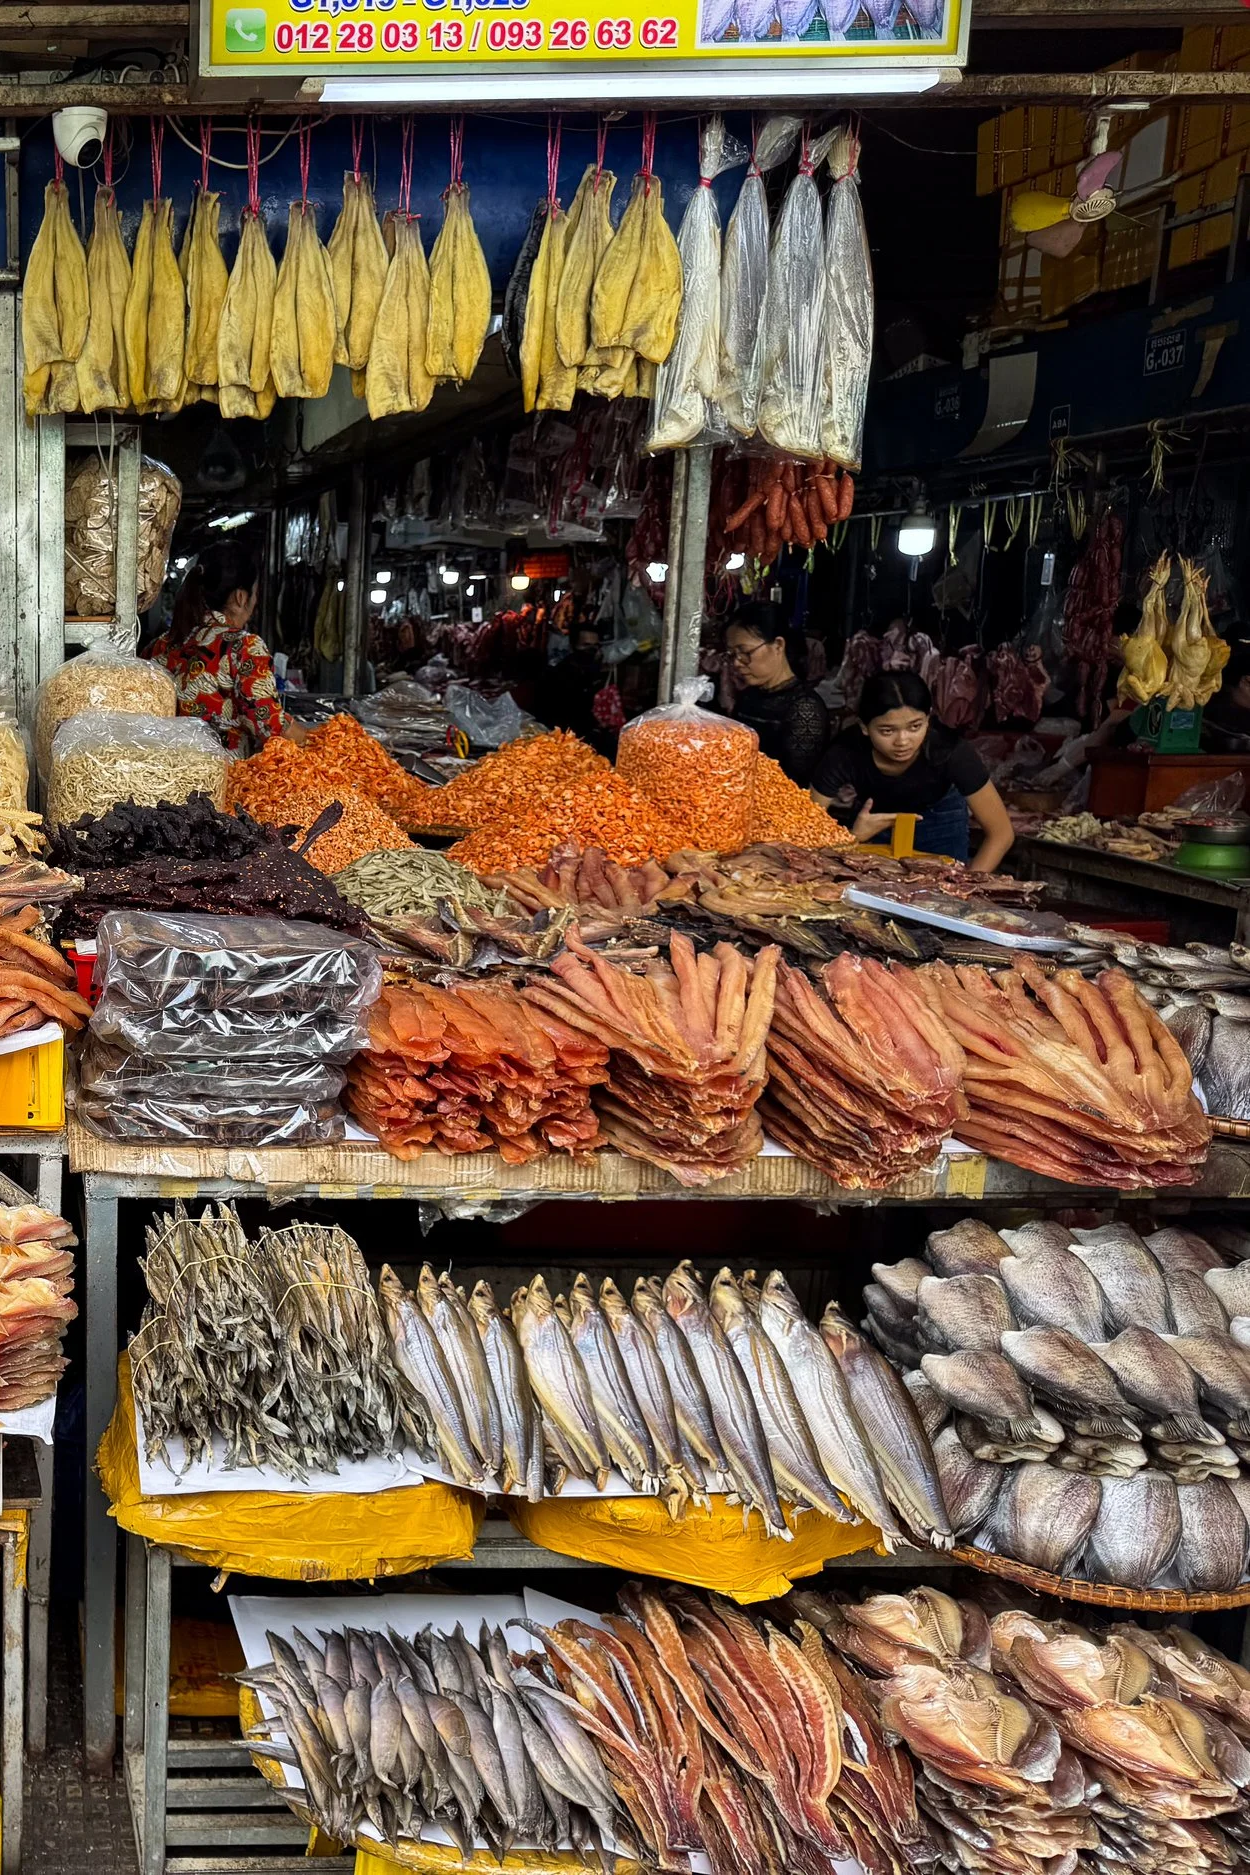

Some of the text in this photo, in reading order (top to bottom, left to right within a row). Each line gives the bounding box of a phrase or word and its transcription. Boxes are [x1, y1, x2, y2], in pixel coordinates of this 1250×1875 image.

[276, 19, 677, 49] 012 28 03 13 / 093 26 63 62
